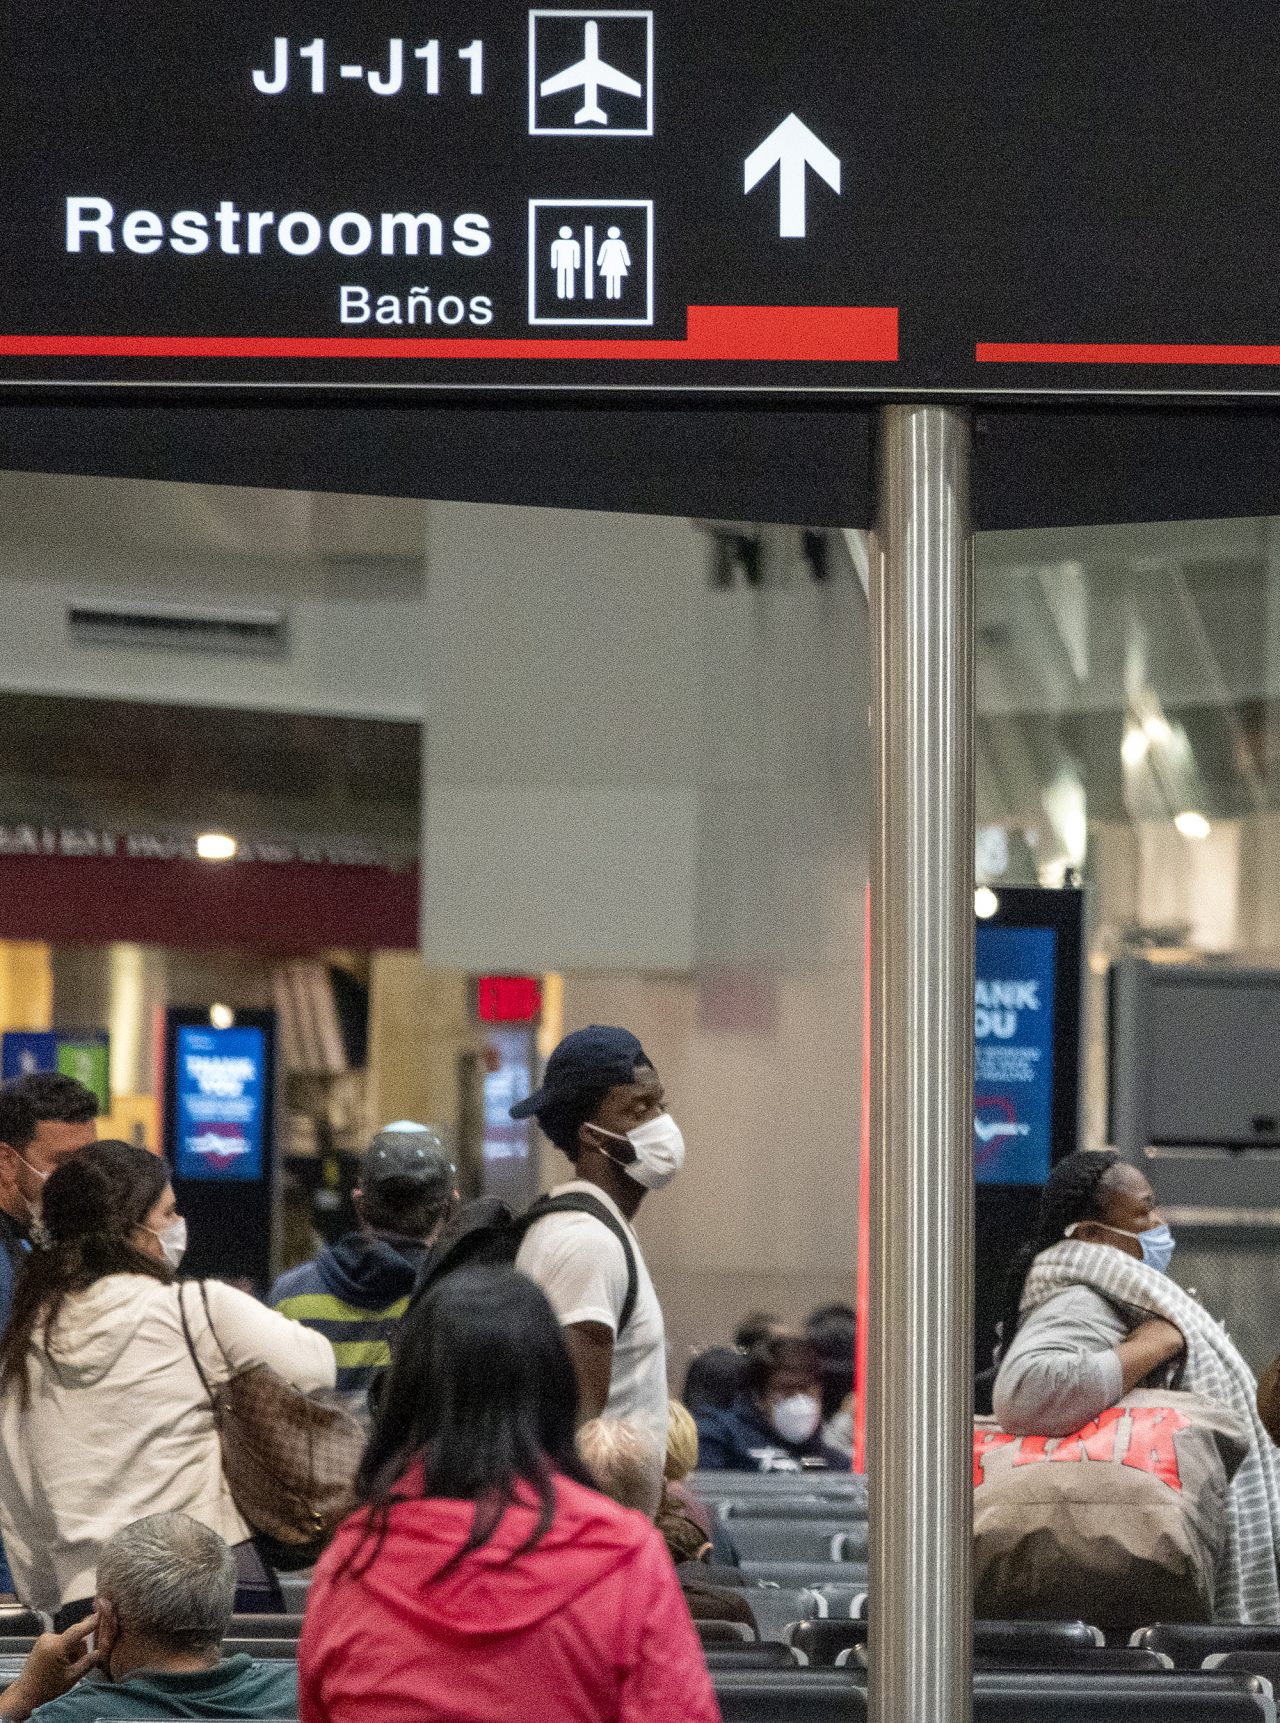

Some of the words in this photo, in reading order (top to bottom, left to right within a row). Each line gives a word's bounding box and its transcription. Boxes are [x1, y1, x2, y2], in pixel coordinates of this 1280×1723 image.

[252, 37, 484, 96] J1-J11
[65, 196, 492, 258] Restrooms
[339, 285, 494, 326] Baños
[974, 980, 1040, 1010] ANK
[974, 1009, 1017, 1038] OU
[974, 1407, 1190, 1493] PINK
